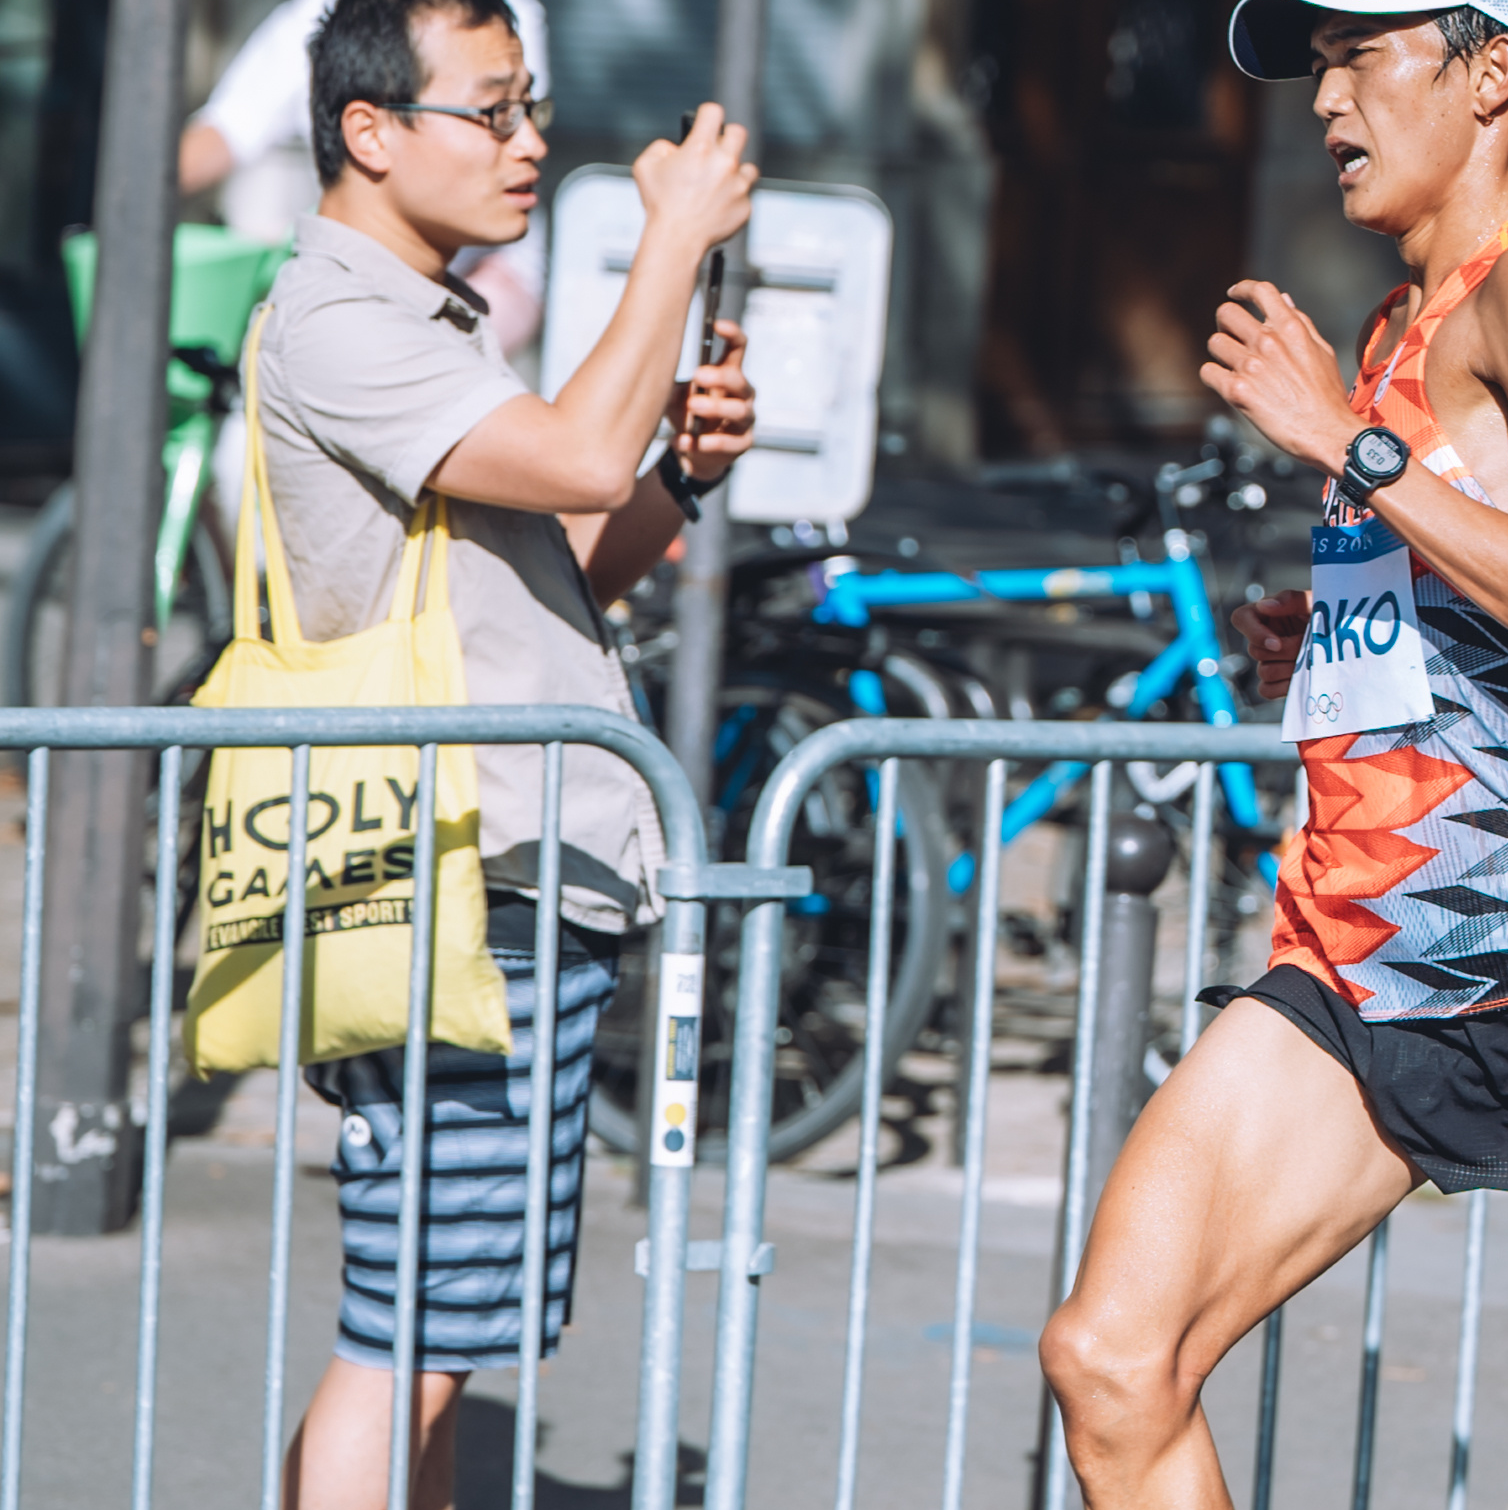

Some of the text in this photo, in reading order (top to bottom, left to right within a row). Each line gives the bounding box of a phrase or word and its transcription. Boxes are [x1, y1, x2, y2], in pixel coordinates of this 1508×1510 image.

[1293, 590, 1401, 674] AKO
[205, 776, 419, 858] HOLY
[208, 846, 415, 907] GAMES
